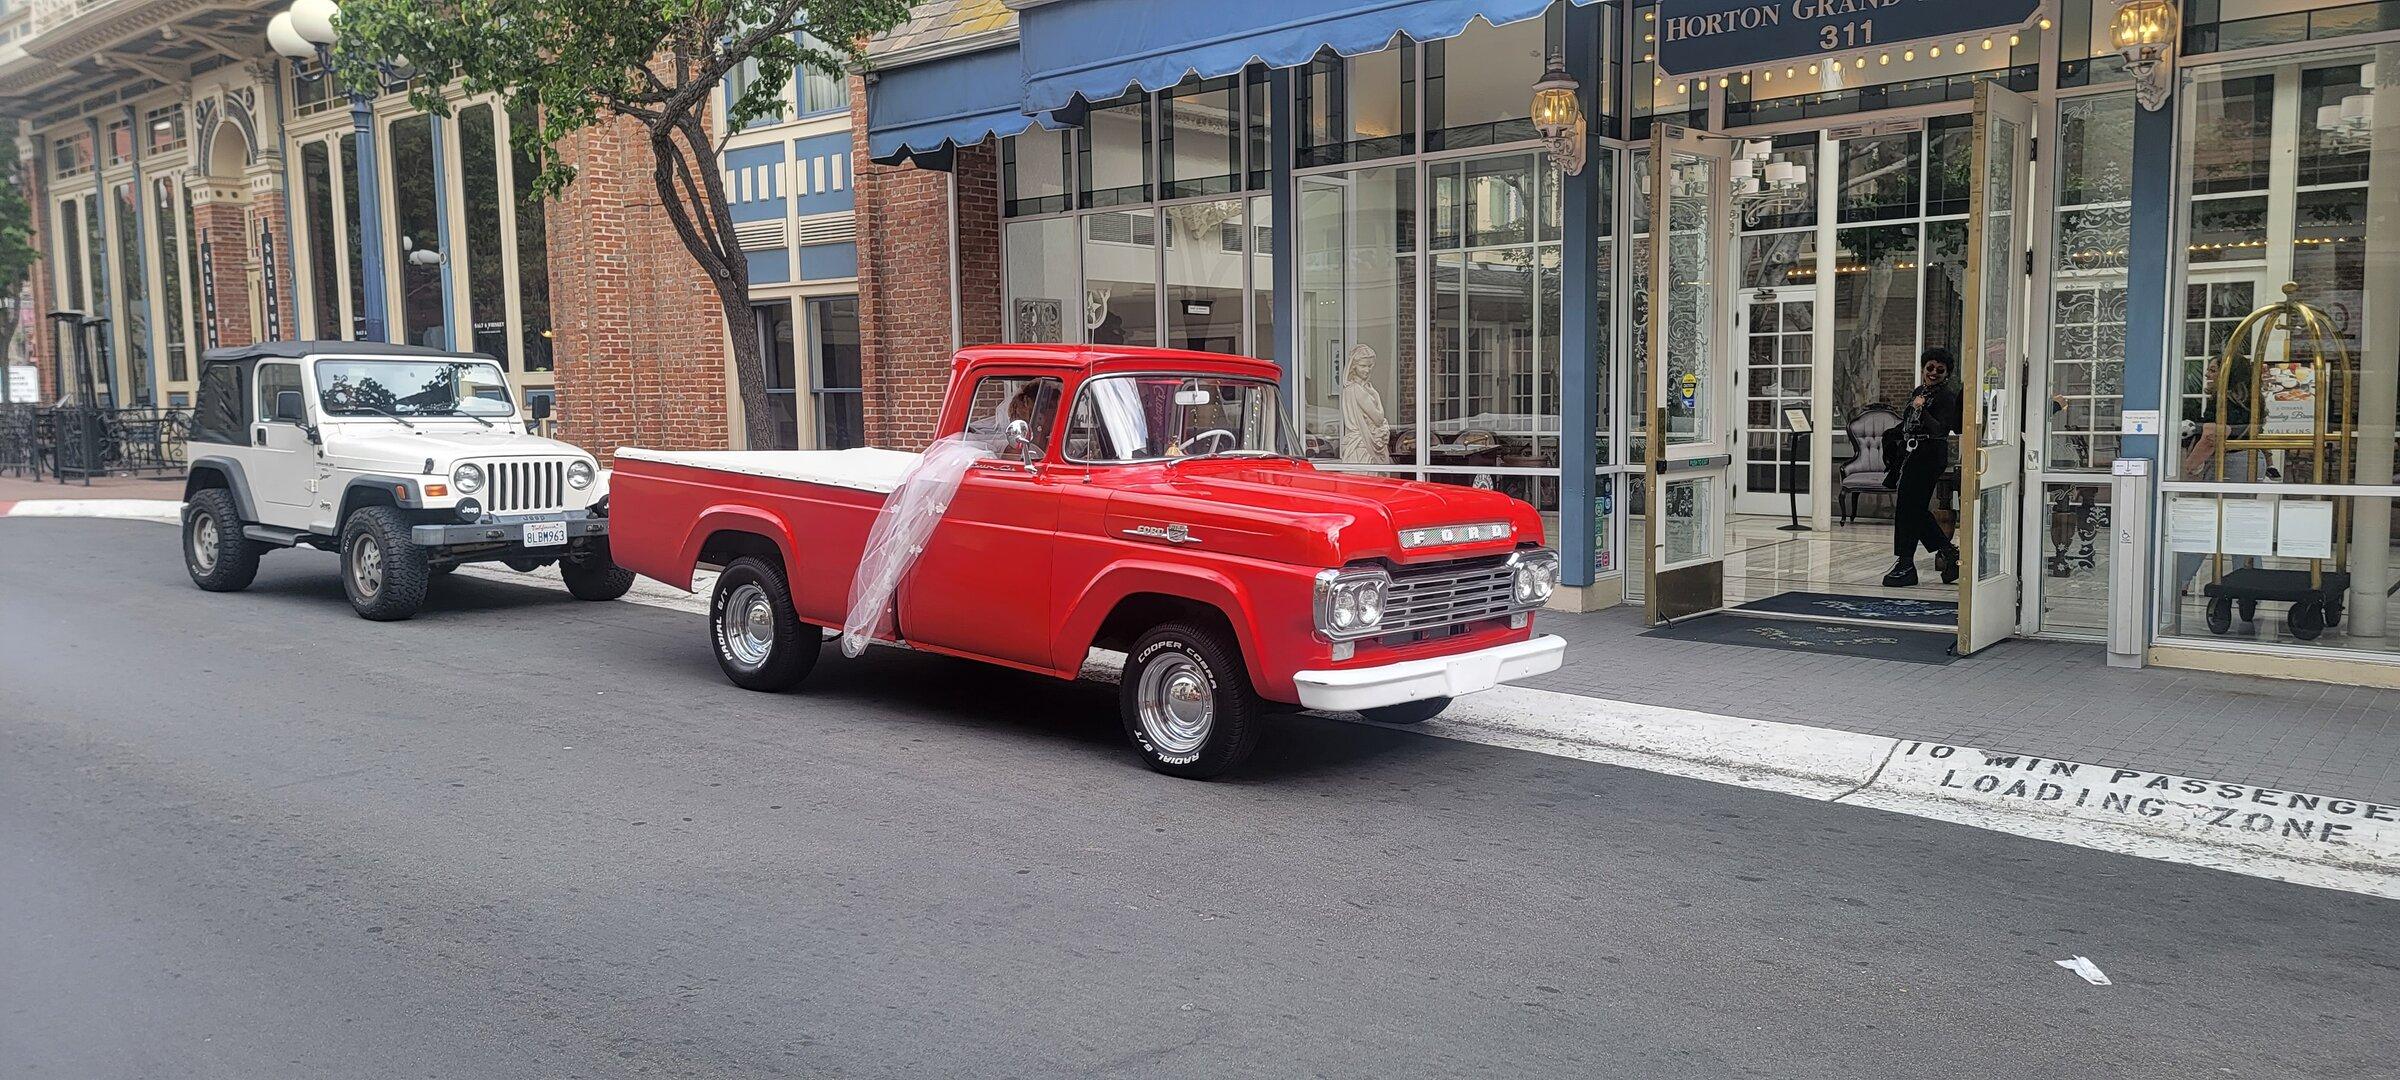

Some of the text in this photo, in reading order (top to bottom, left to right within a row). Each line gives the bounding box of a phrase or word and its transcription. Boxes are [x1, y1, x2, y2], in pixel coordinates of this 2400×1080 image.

[1665, 3, 1780, 42] HORTON
[1819, 19, 1873, 50] 311
[203, 252, 212, 296] SALT
[264, 242, 274, 290] SALT
[461, 506, 479, 514] Jeep
[527, 530, 565, 543] 8LBM963
[1137, 525, 1164, 535] FORD
[1413, 525, 1502, 545] FORD
[716, 618, 733, 661] RADIAL
[1137, 640, 1218, 690] COOPER COBRA
[1133, 729, 1200, 765] RADIAL G/T
[1906, 742, 1956, 759] 10
[1984, 755, 2080, 777] MIN
[1940, 768, 2353, 843] LOADING ZONE
